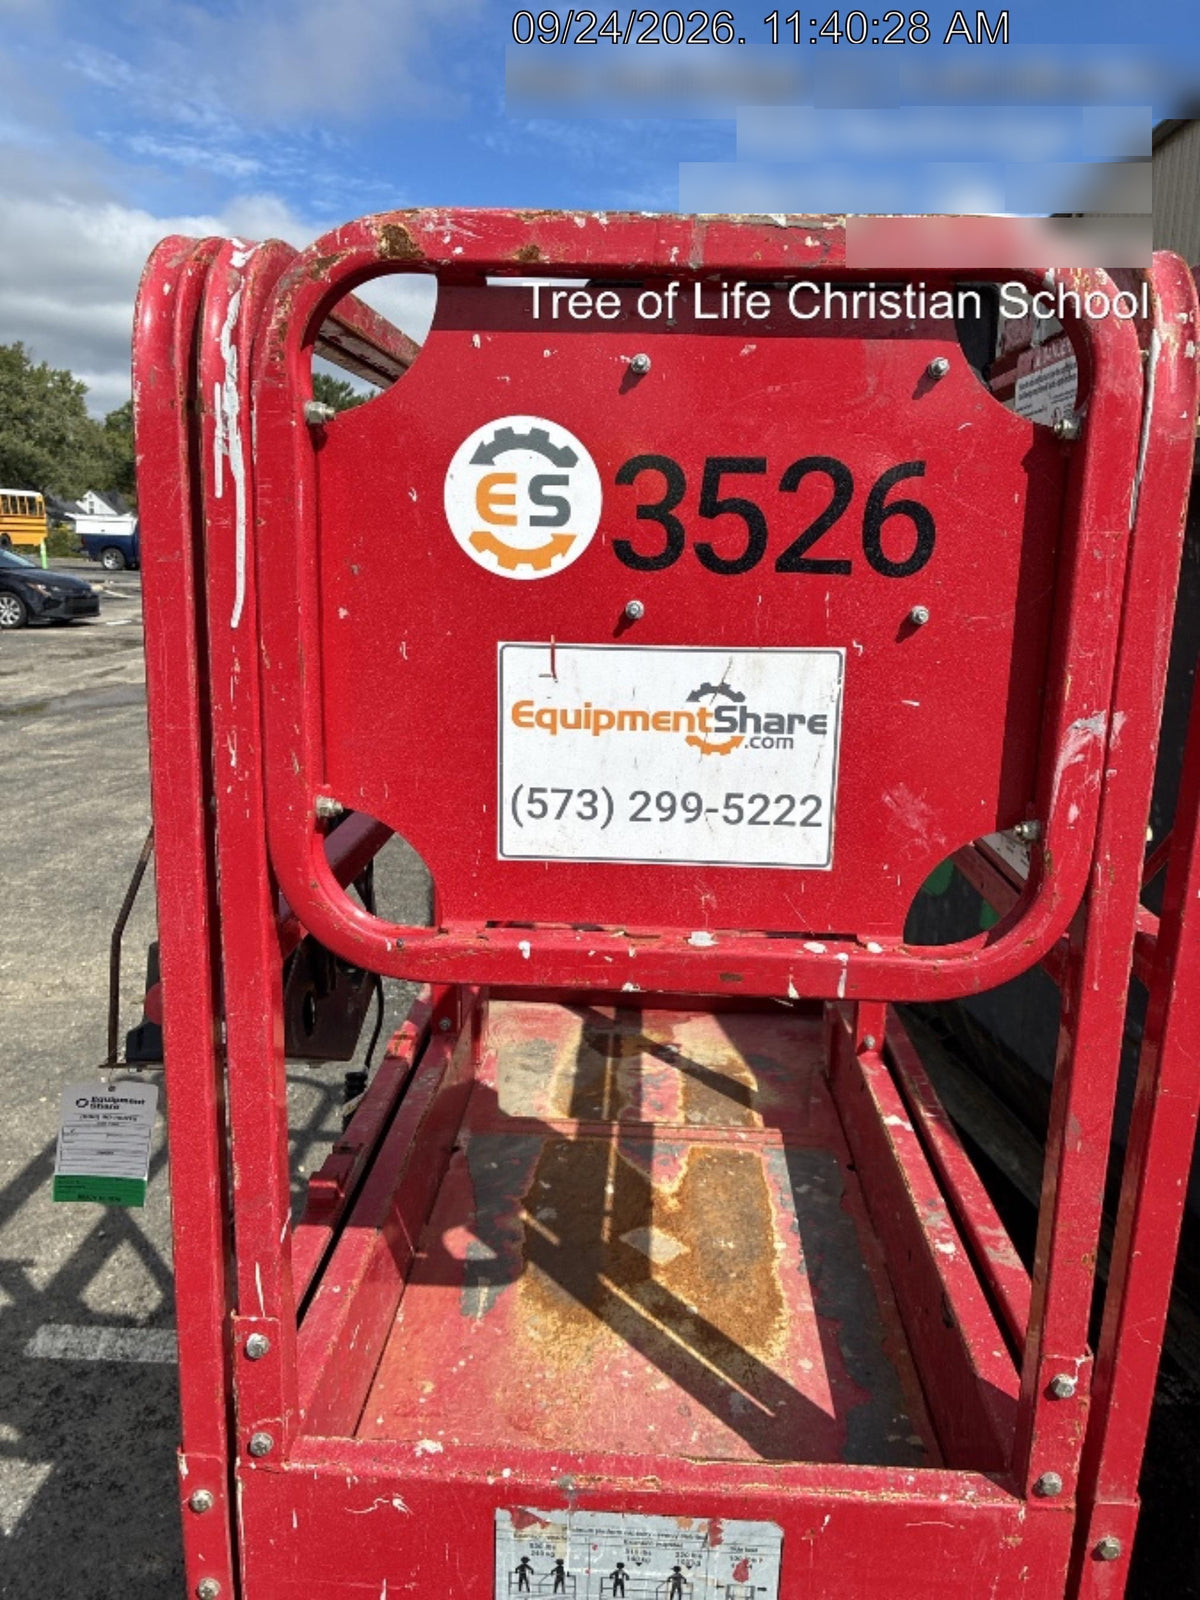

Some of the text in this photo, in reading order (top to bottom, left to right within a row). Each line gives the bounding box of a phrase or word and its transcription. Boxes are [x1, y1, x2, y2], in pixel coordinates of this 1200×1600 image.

[475, 472, 572, 528] ES
[611, 454, 937, 579] 3526
[511, 700, 828, 737] EquipmentShare
[744, 735, 794, 750] .com
[511, 783, 823, 830] (573) 299-5222
